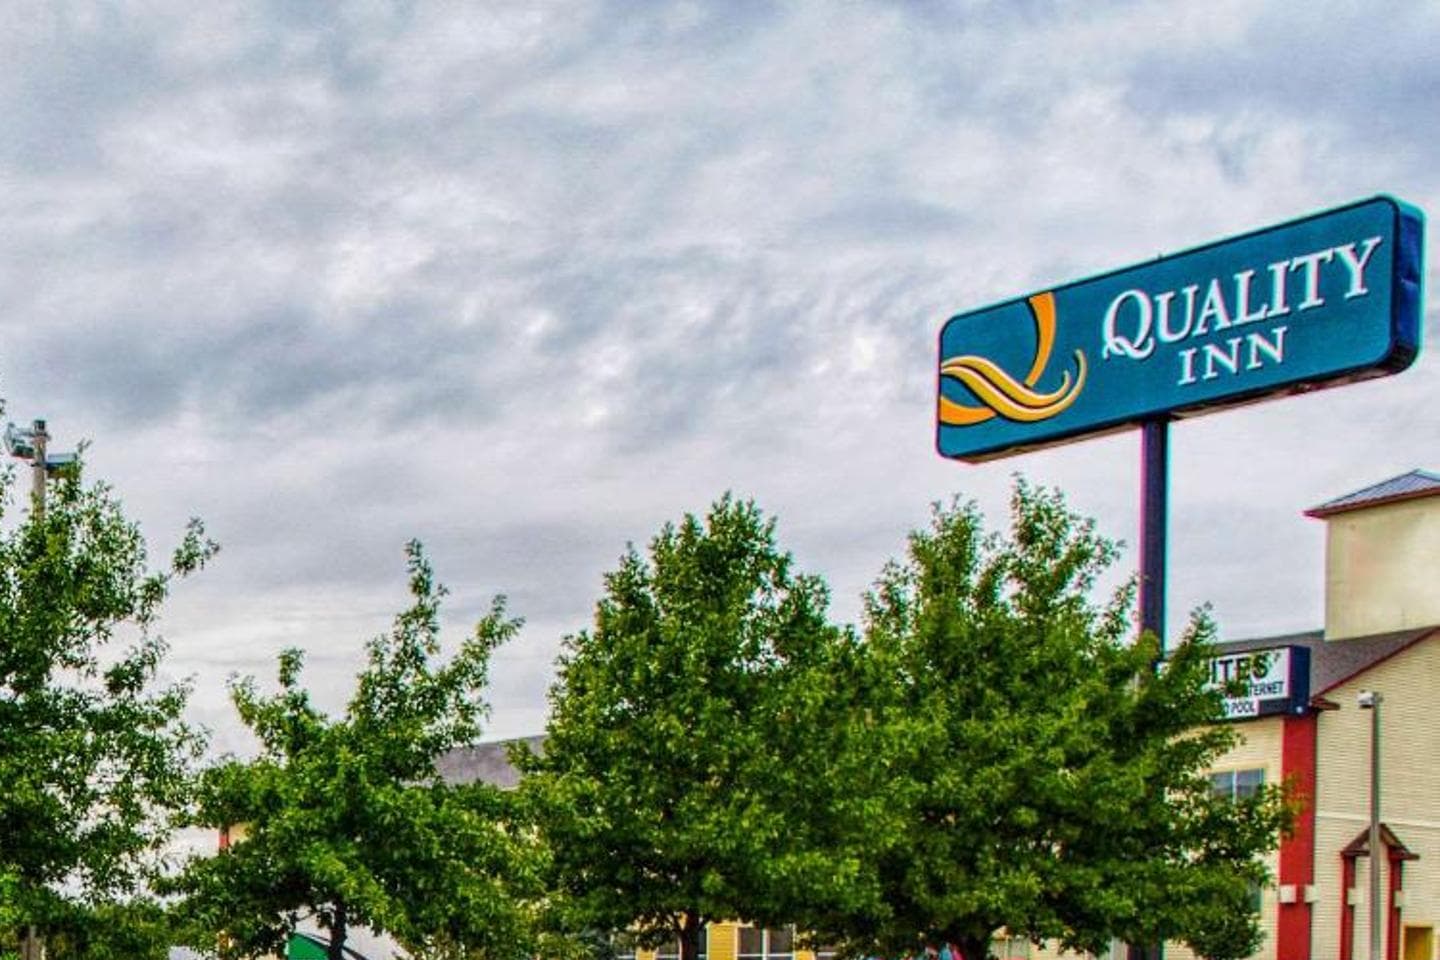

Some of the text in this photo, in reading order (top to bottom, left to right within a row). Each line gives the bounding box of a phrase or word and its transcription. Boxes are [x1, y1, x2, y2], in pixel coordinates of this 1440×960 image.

[1101, 236, 1381, 360] QUALITY
[1178, 326, 1288, 386] INN
[1211, 653, 1268, 684] ITES
[1249, 681, 1284, 696] TERNET
